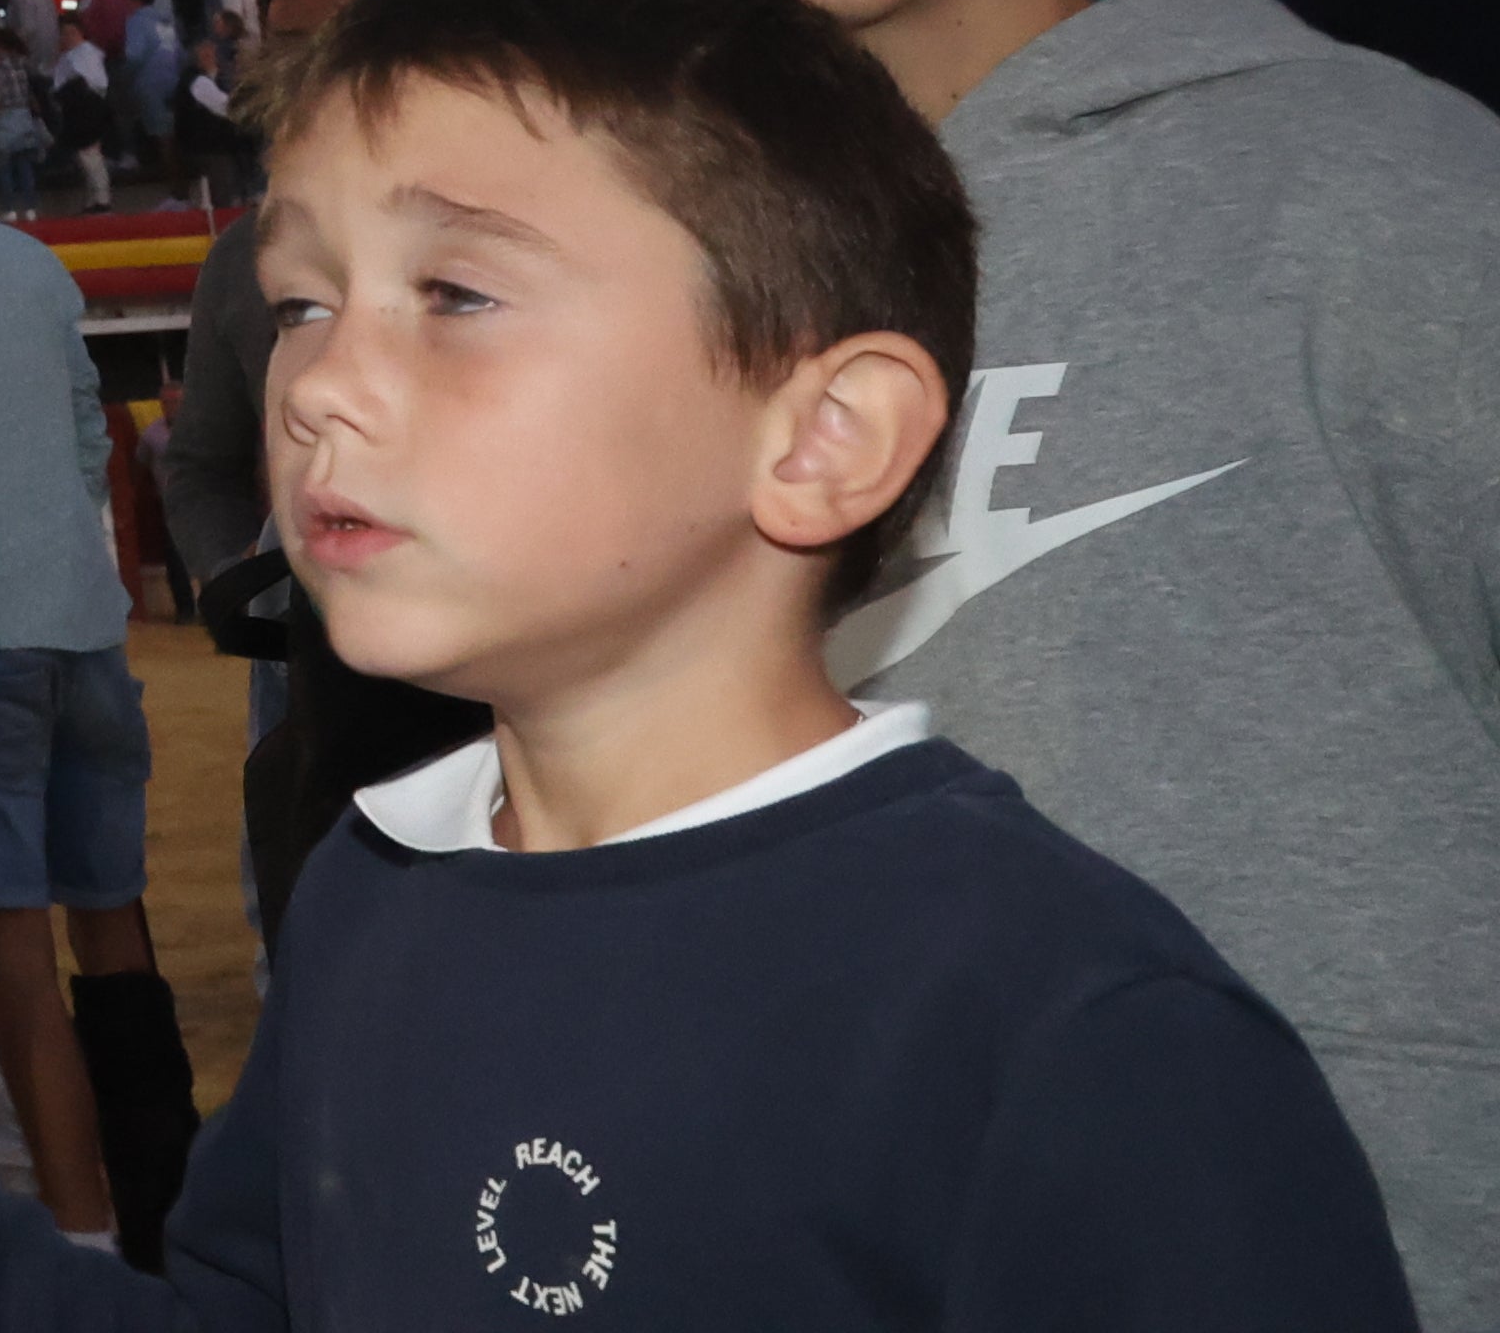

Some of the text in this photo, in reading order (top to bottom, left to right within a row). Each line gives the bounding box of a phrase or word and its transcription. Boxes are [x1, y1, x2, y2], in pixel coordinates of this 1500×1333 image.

[476, 1137, 617, 1316] REACH THE NEXT LEVEL
